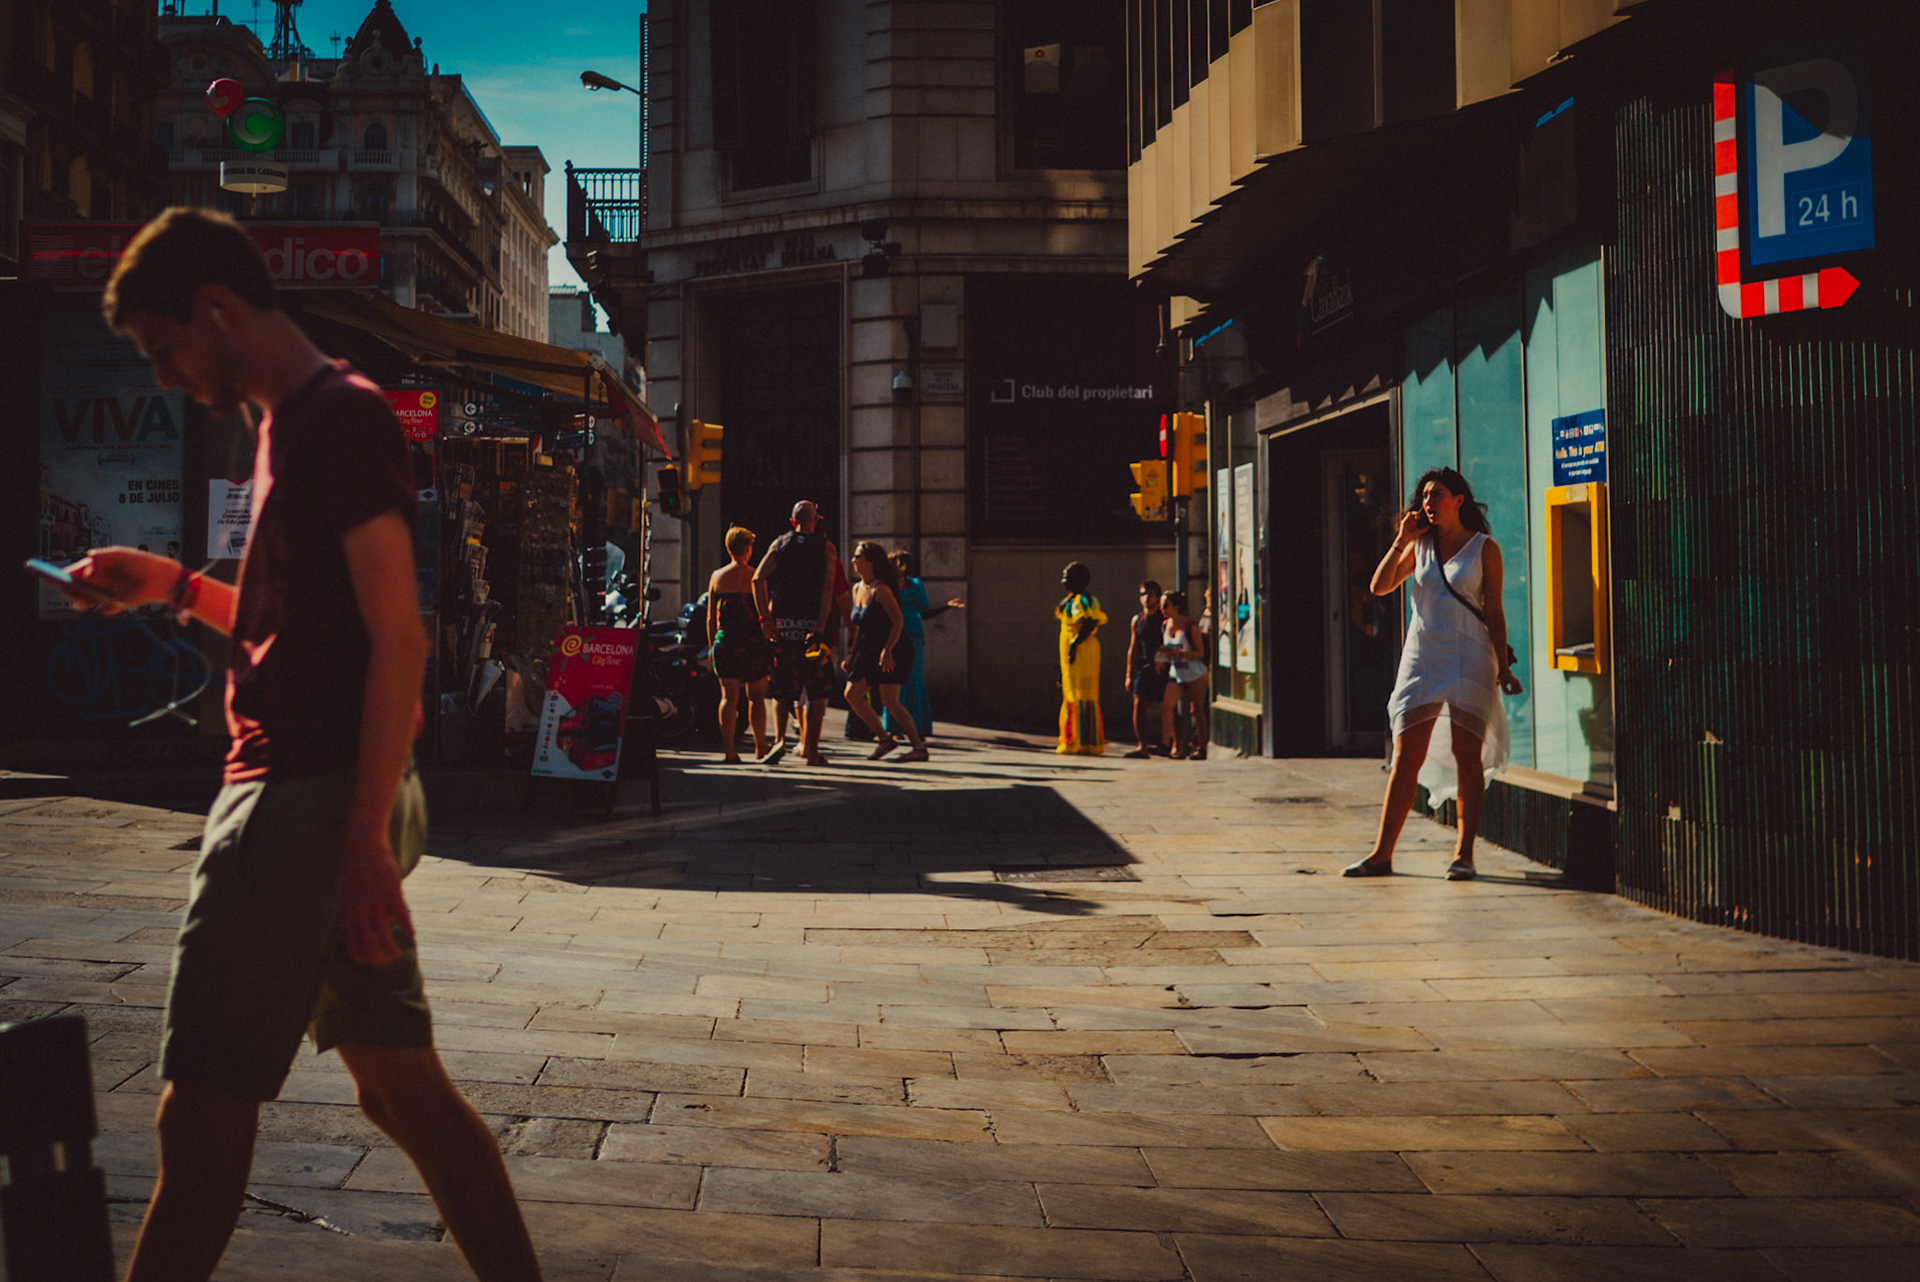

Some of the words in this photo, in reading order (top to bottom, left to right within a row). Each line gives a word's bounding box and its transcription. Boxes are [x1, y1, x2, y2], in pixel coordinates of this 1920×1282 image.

[1754, 58, 1858, 238] P
[1798, 194, 1830, 226] 24
[1841, 190, 1858, 219] h
[782, 243, 836, 266] URBANA
[1021, 384, 1054, 399] Club
[1058, 385, 1079, 399] del
[1083, 385, 1153, 401] propietari
[52, 395, 179, 443] VIVA
[393, 409, 433, 418] ARCELONA
[128, 480, 143, 491] EN
[146, 479, 179, 491] CINES
[119, 492, 126, 504] 8
[129, 492, 144, 504] DE
[147, 491, 180, 504] JULIO
[582, 642, 634, 656] BARCELONA
[592, 655, 606, 667] City
[605, 656, 622, 666] Tour
